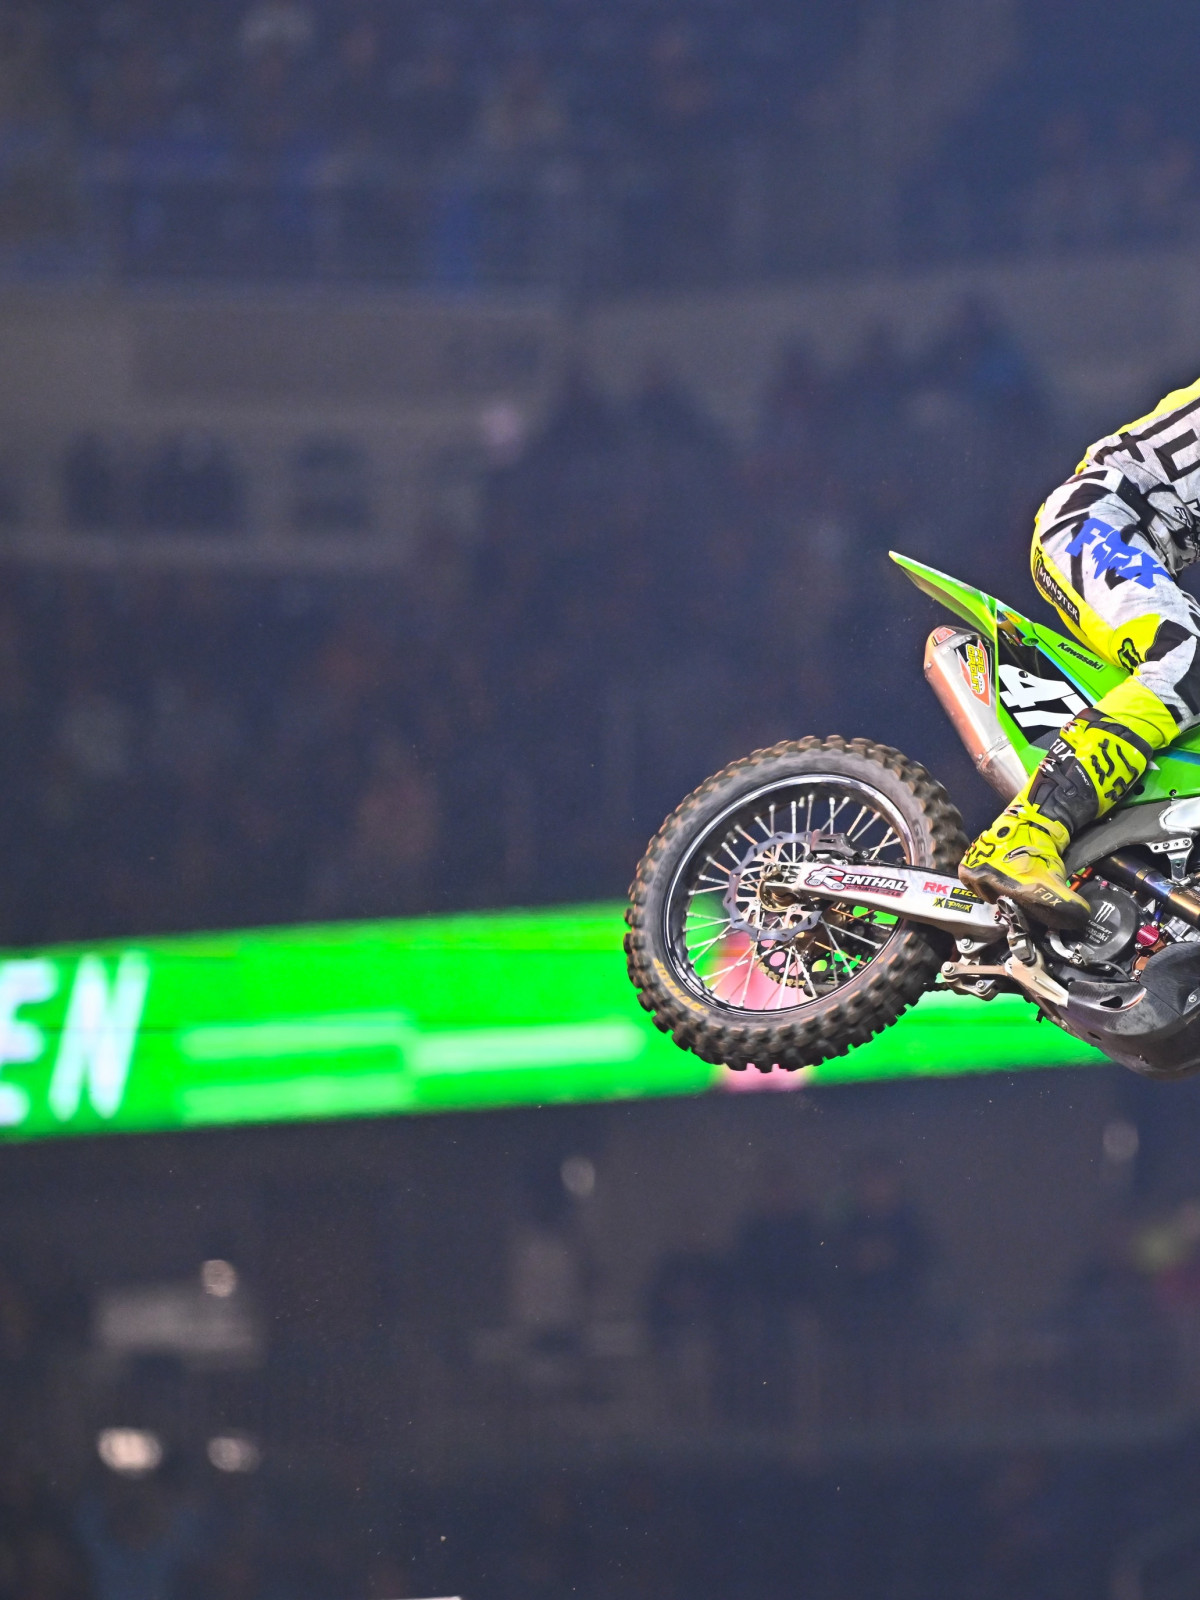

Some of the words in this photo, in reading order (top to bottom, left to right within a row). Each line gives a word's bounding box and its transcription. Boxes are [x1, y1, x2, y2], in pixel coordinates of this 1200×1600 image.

[1038, 564, 1079, 621] MONSTER
[966, 644, 981, 693] CIRCUIT
[974, 647, 986, 675] PRO
[1057, 642, 1104, 672] Kawasaki
[1049, 738, 1076, 761] FOX
[805, 866, 908, 892] RENTHAL
[923, 881, 950, 895] RK
[952, 888, 979, 898] EXC
[1033, 887, 1063, 907] FOX
